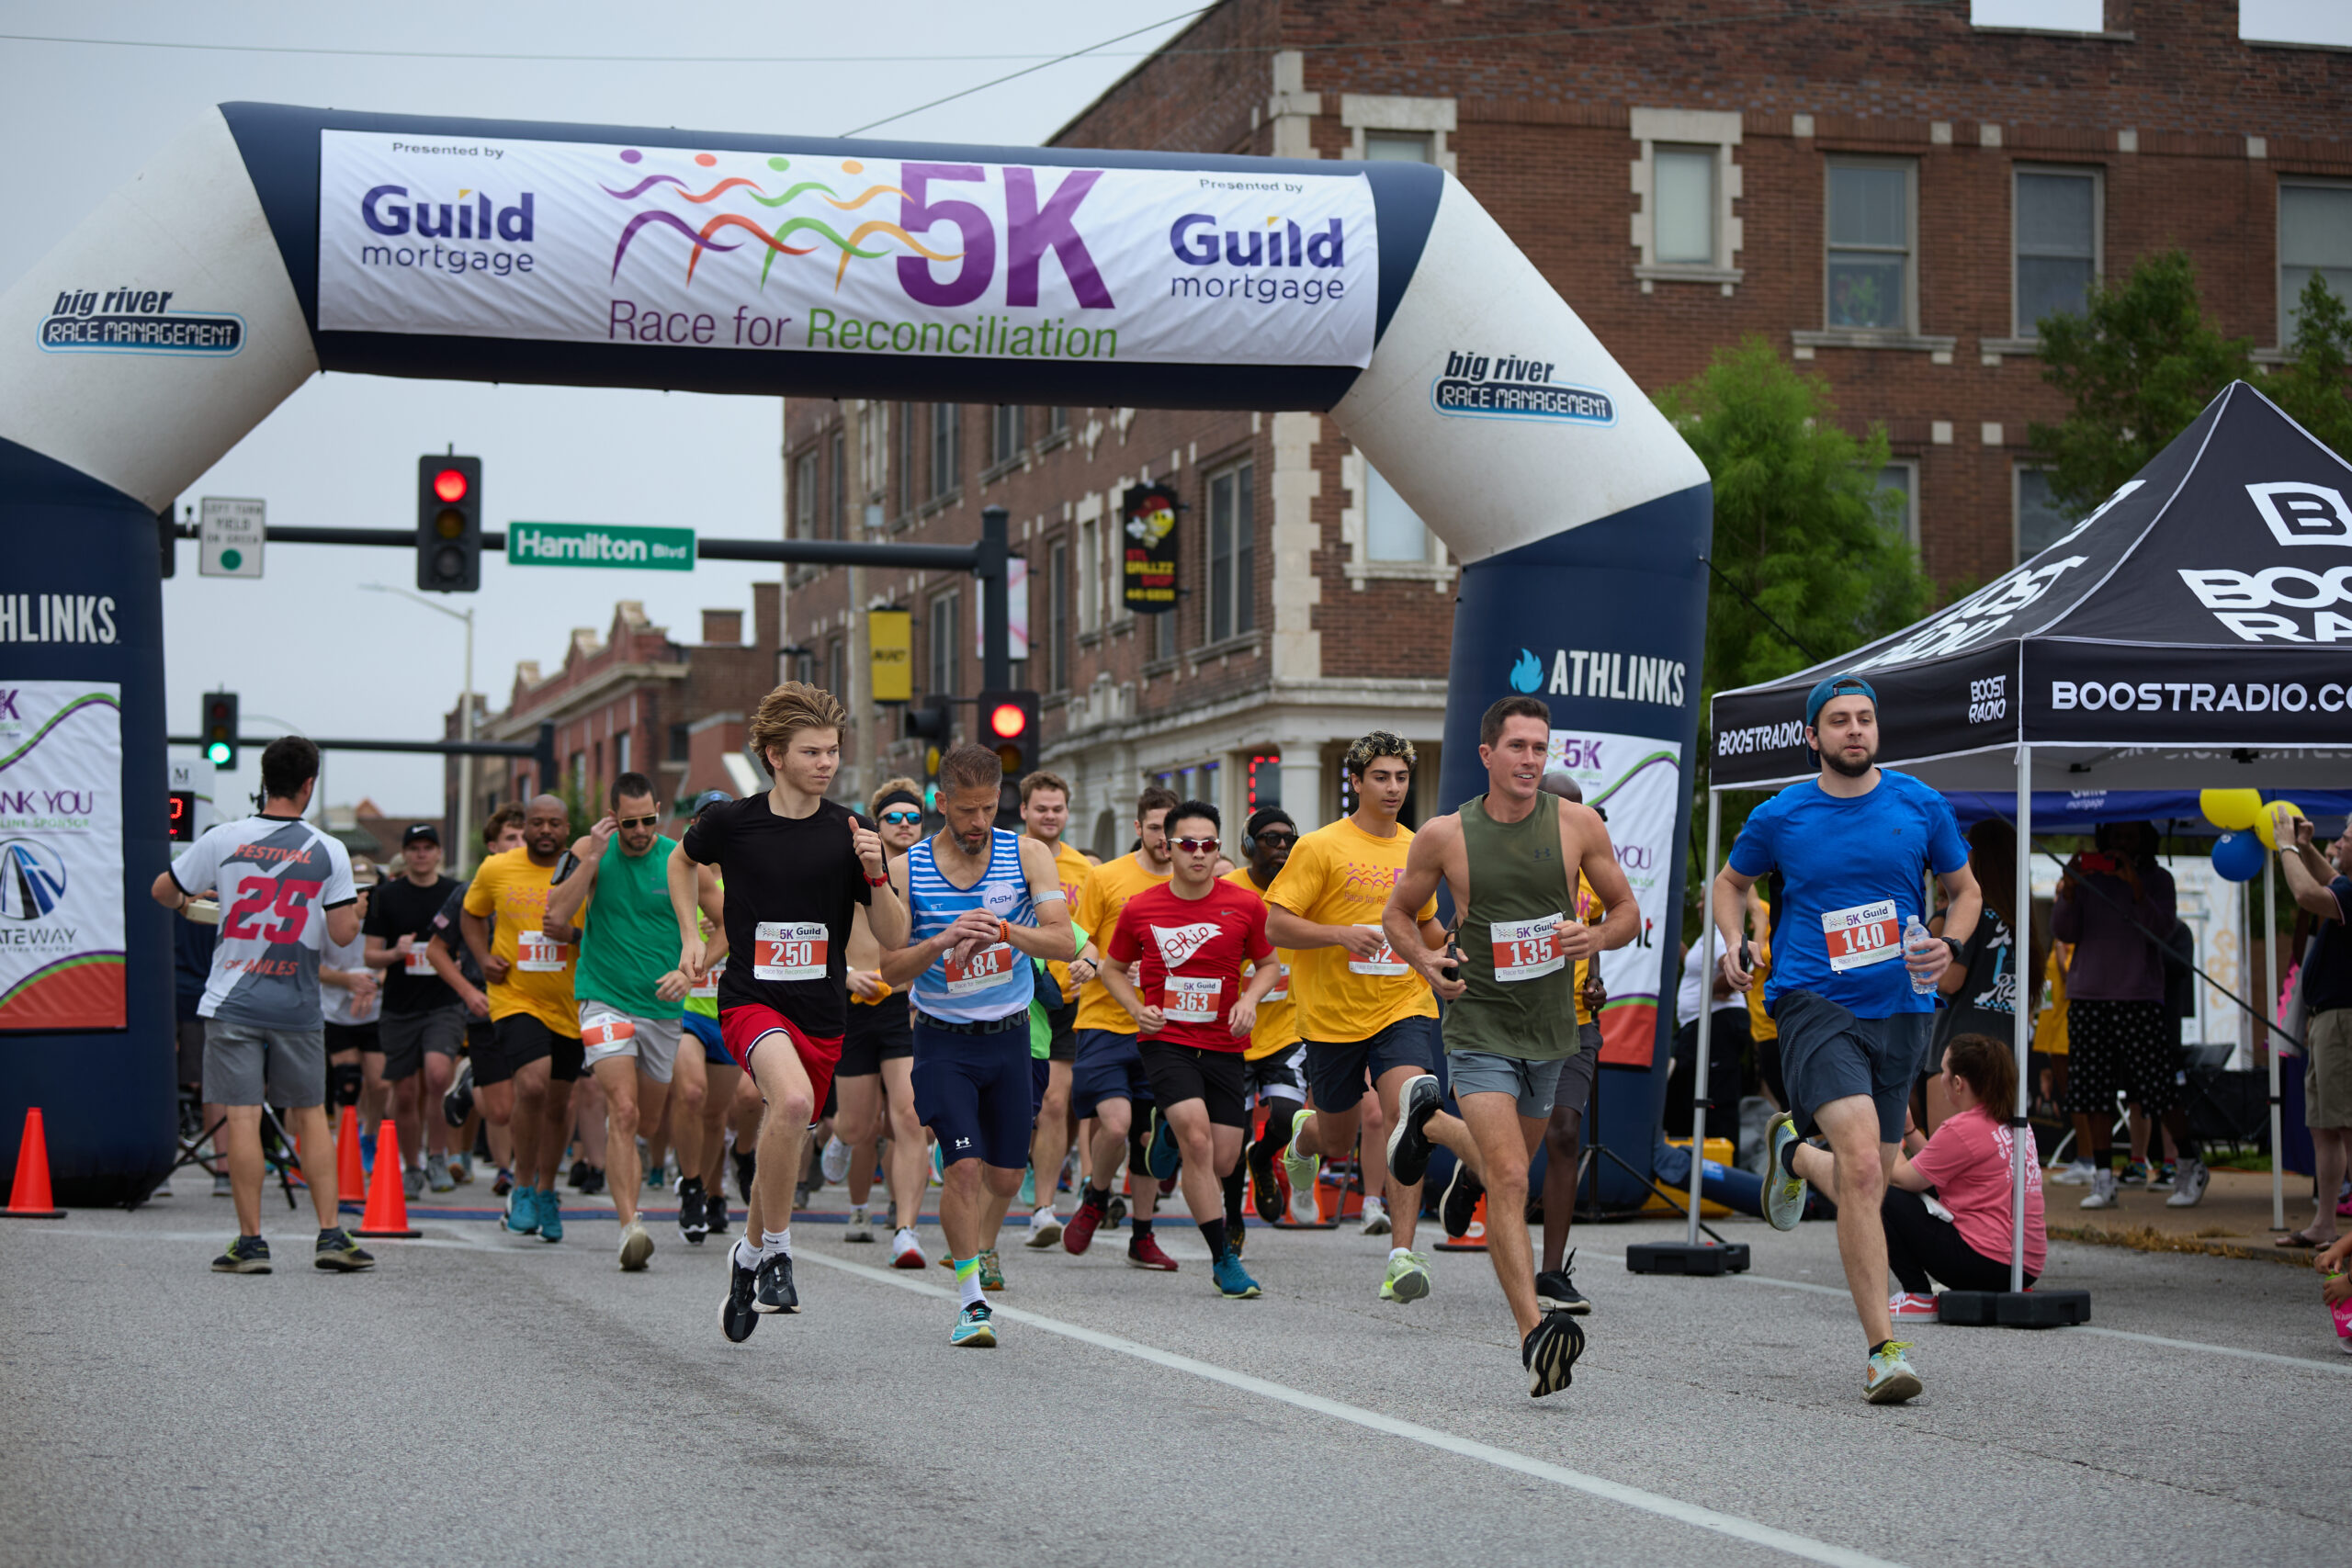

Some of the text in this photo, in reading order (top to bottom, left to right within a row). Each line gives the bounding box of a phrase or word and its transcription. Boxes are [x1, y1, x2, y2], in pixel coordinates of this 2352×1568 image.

[392, 142, 504, 160] Presented by
[1200, 178, 1304, 195] Presented by
[361, 185, 535, 243] Guild
[897, 162, 1116, 309] 5K
[1170, 212, 1344, 268] Guild
[362, 243, 535, 276] mortgage
[1170, 273, 1344, 305] mortgage
[52, 287, 174, 319] big river
[48, 321, 235, 347] RACE MANAGEMENT
[608, 299, 1118, 359] Race for Reconciliation
[1444, 350, 1555, 384] big river
[1442, 386, 1608, 419] RACE MANAGEMENT
[517, 529, 687, 561] Hamilton Blvd
[0, 594, 117, 644] HLINKS
[1549, 649, 1686, 707] ATHLINKS
[1971, 675, 2007, 702] BOOST
[2052, 681, 2352, 712] BOOSTRADIO.C
[1969, 698, 2007, 724] RADIO
[1564, 738, 1603, 770] 5K
[0, 790, 93, 815] NK YOU
[234, 843, 313, 863] FESTIVAL
[1613, 844, 1652, 870] YOU
[223, 875, 323, 945] 25
[989, 895, 1012, 905] ASH
[1344, 891, 1363, 903] Race
[1365, 894, 1374, 904] for
[1846, 906, 1889, 926] 5K Guild
[779, 927, 821, 940] 5K Guild
[1164, 927, 1209, 959] Ohio
[1516, 926, 1532, 939] 5K
[1841, 923, 1886, 955] 140
[529, 945, 558, 962] 110
[770, 941, 812, 966] 250
[1510, 936, 1553, 967] 135
[224, 958, 300, 976] OF MILES
[962, 952, 1000, 980] 184
[1183, 982, 1194, 991] 5K
[1175, 991, 1209, 1012] 363
[602, 1024, 615, 1043] 8
